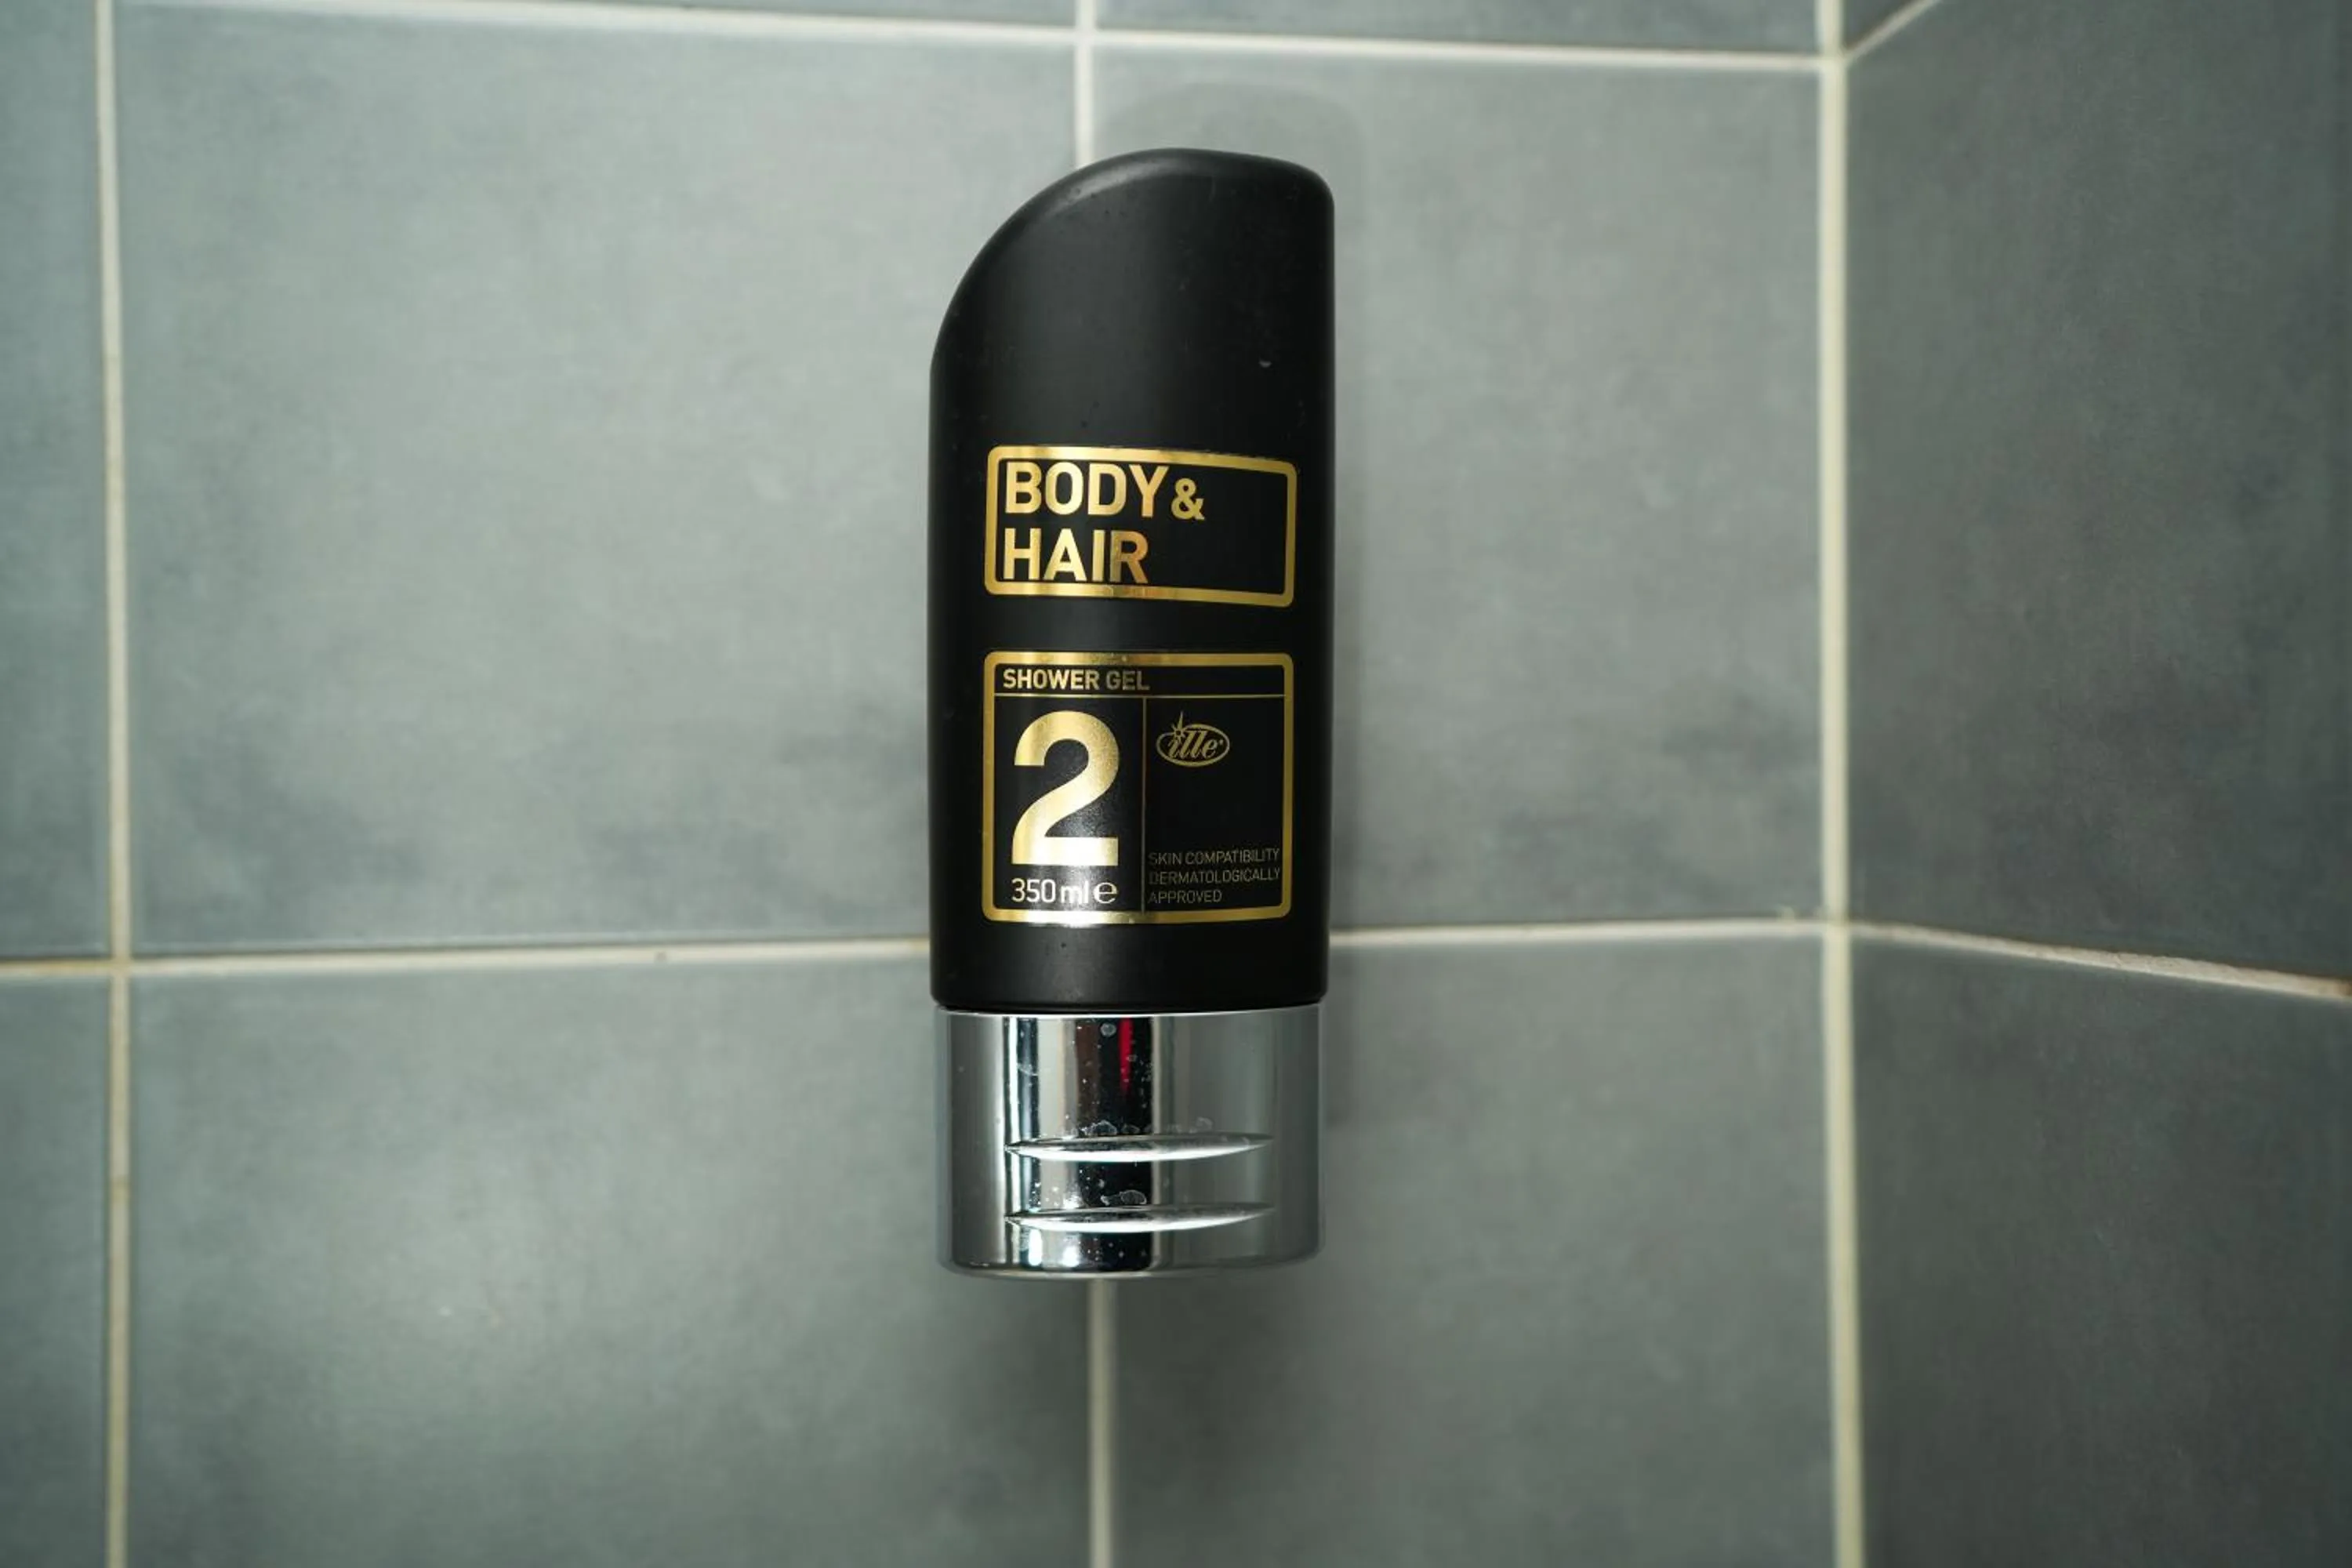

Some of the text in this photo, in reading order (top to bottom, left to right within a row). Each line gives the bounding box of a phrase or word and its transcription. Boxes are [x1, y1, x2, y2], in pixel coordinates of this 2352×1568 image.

[1004, 461, 1206, 521] BODY &
[1003, 528, 1149, 584] HAIR
[1003, 668, 1150, 691] SHOWER GEL
[1011, 710, 1120, 866] 2
[1148, 848, 1280, 866] SKIN COMPATIBILITY
[1148, 867, 1280, 885] DERMATOLOGICALLY
[1011, 877, 1057, 903] 350
[1060, 880, 1089, 905] ml
[1148, 890, 1223, 904] APPROVED
